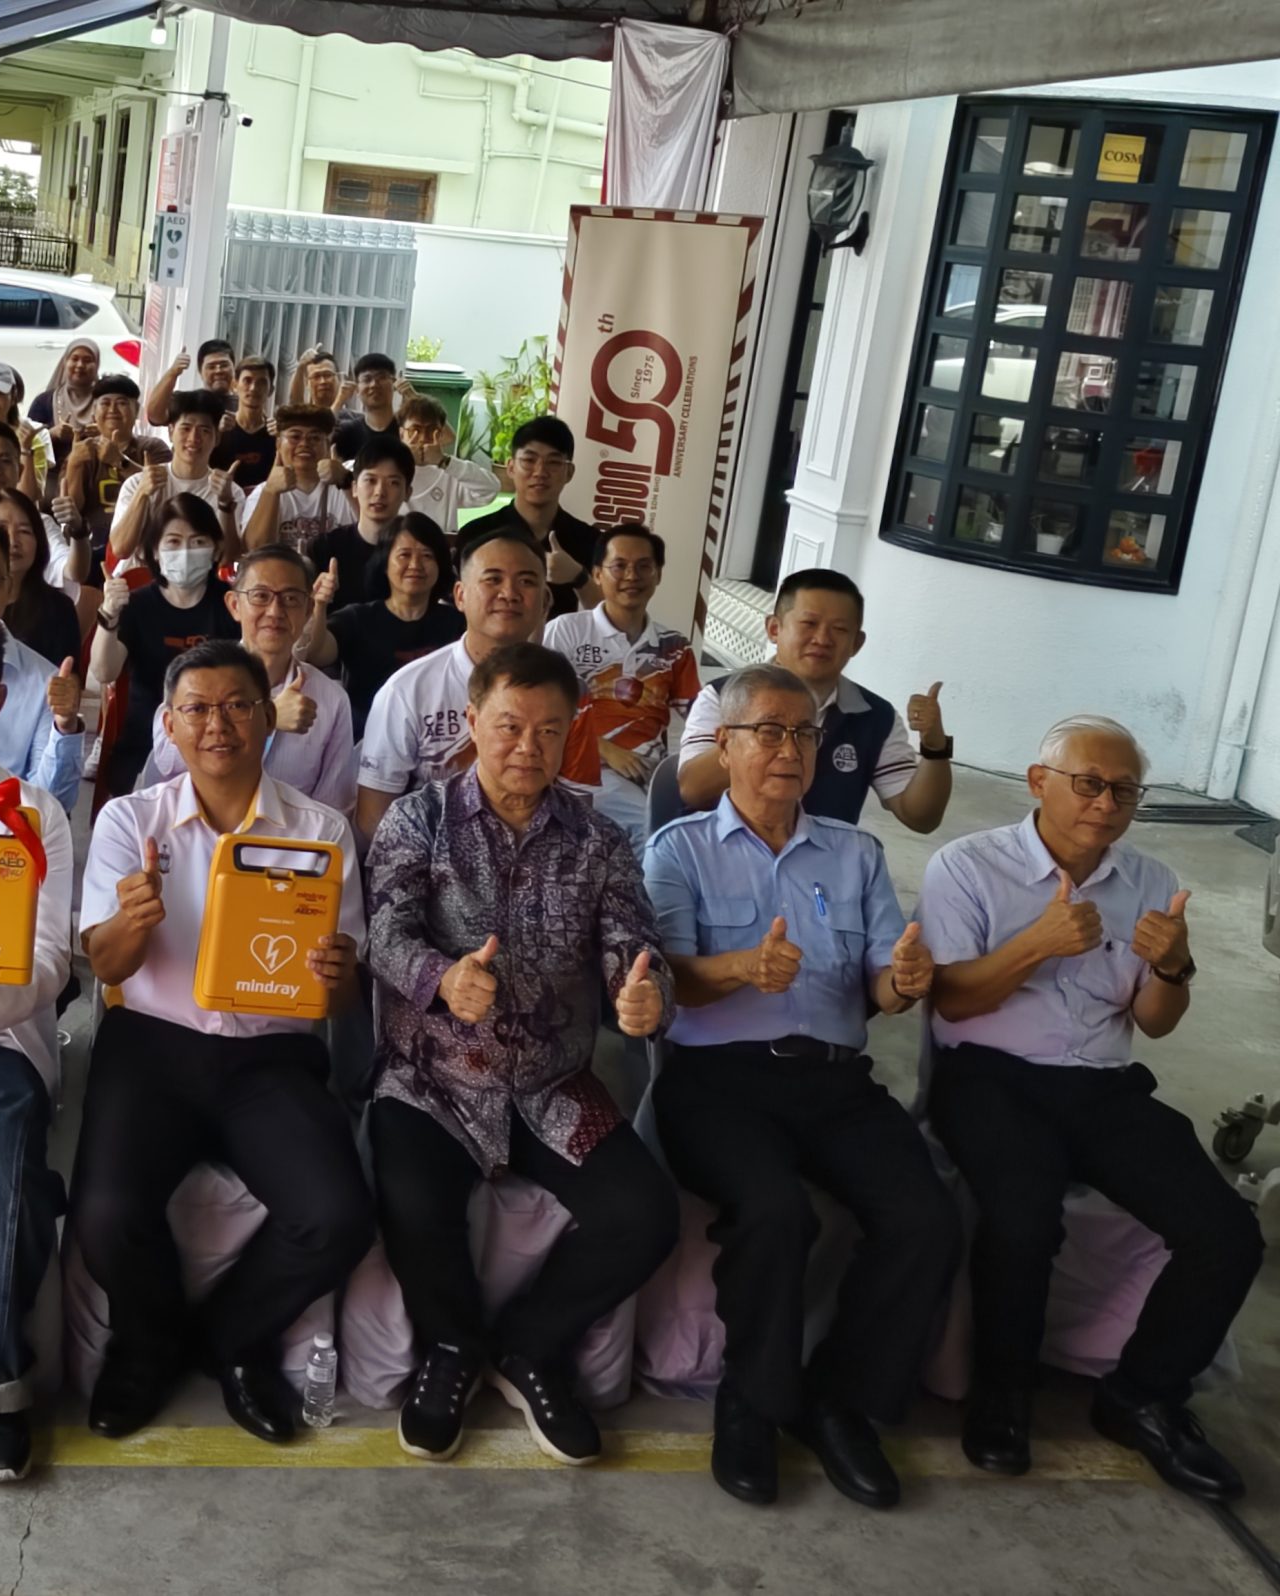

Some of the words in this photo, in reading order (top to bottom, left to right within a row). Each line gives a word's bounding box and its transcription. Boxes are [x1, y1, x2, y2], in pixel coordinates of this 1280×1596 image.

[166, 216, 186, 226] AED
[598, 313, 615, 334] th
[643, 354, 655, 385] 1975
[631, 368, 643, 399] Since
[673, 419, 689, 478] ANNIVERSARY
[681, 355, 698, 418] CELEBRATIONS
[424, 723, 461, 738] AED
[236, 979, 300, 999] mindray
